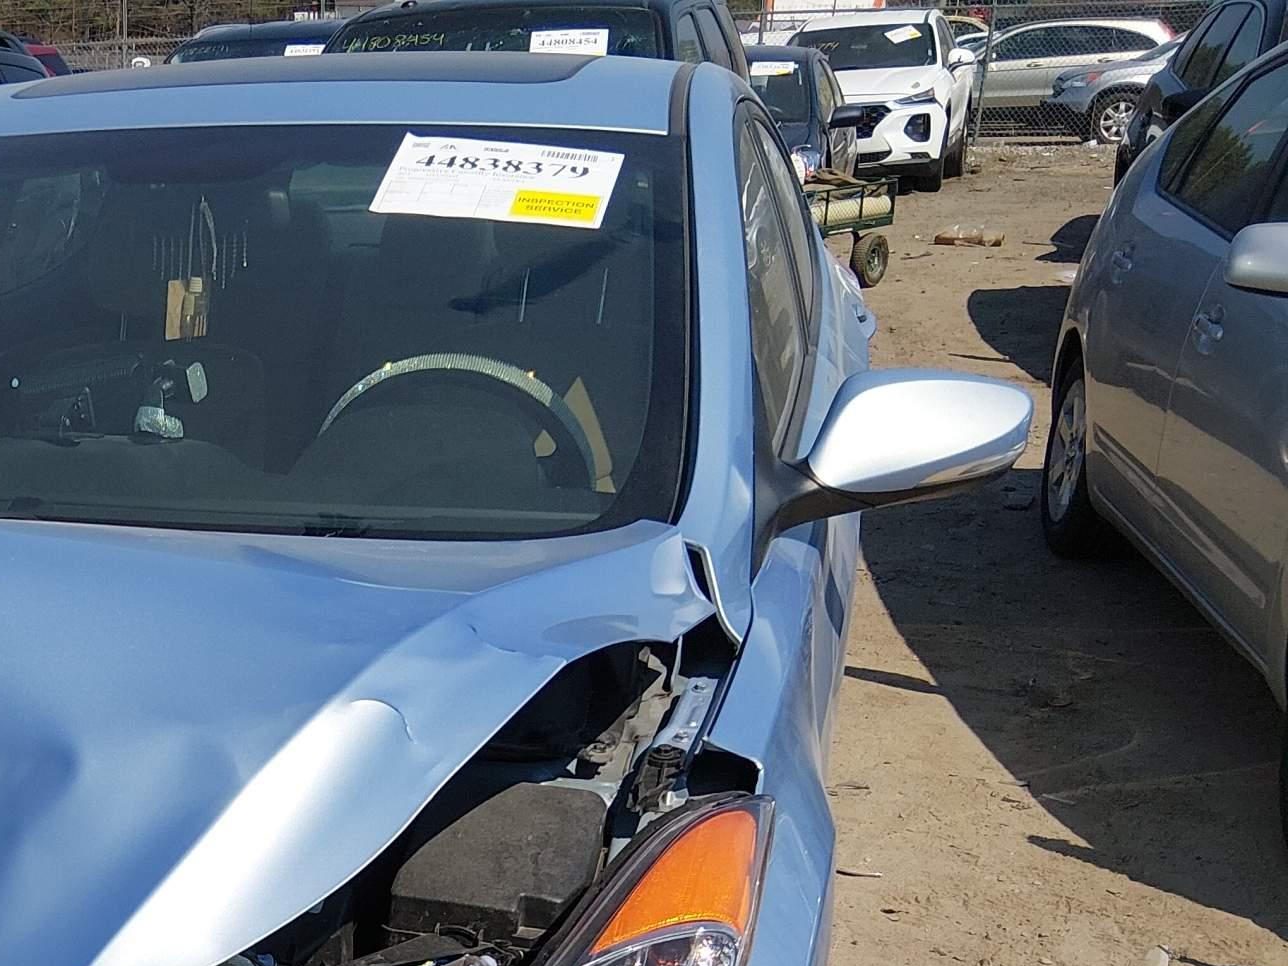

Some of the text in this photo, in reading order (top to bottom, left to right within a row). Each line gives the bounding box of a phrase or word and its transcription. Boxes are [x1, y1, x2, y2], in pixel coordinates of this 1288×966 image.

[538, 37, 598, 47] 44808454
[415, 154, 590, 179] 44838379
[518, 196, 595, 209] INSPECTION
[525, 204, 582, 215] SERVICE
